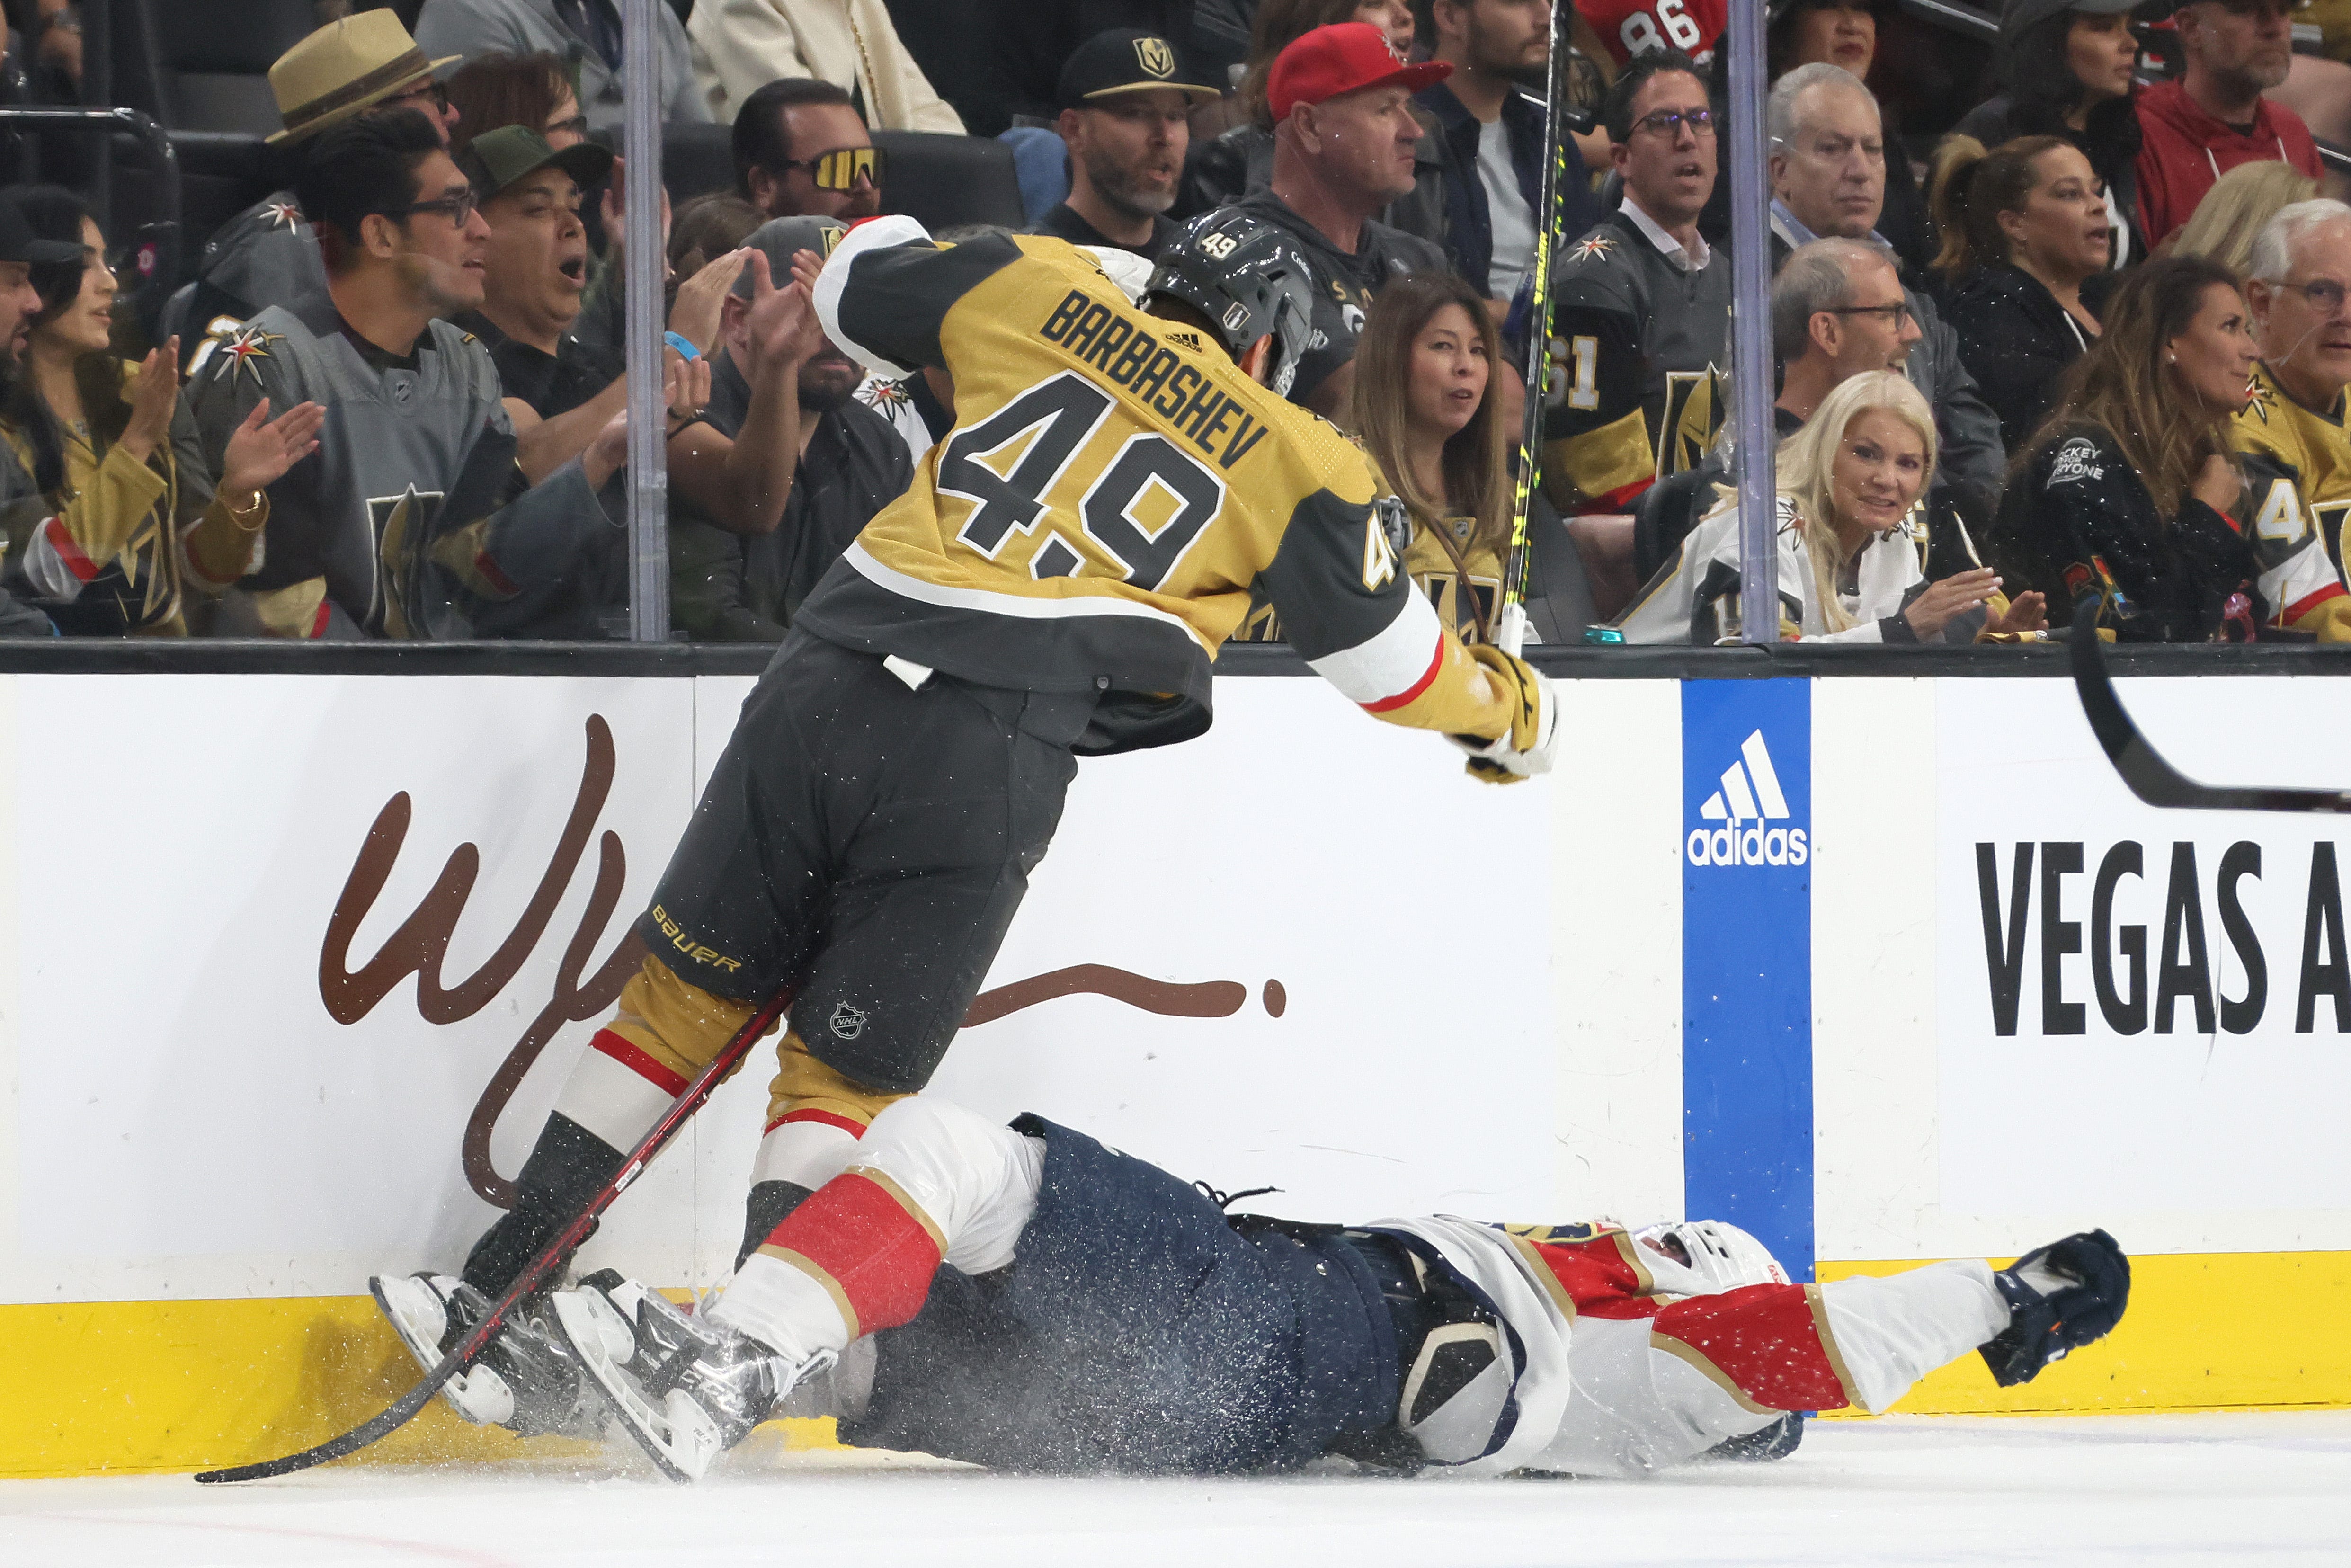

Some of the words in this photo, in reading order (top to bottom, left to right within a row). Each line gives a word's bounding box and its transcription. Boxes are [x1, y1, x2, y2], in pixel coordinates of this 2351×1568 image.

[1202, 232, 1238, 259] 49
[1165, 334, 1202, 353] adidas
[1040, 289, 1268, 470] BARBASHEV
[935, 368, 1227, 593] 49
[1687, 817, 1808, 866] adidas
[1975, 840, 2268, 1036] VEGAS
[836, 1016, 857, 1026] NHL
